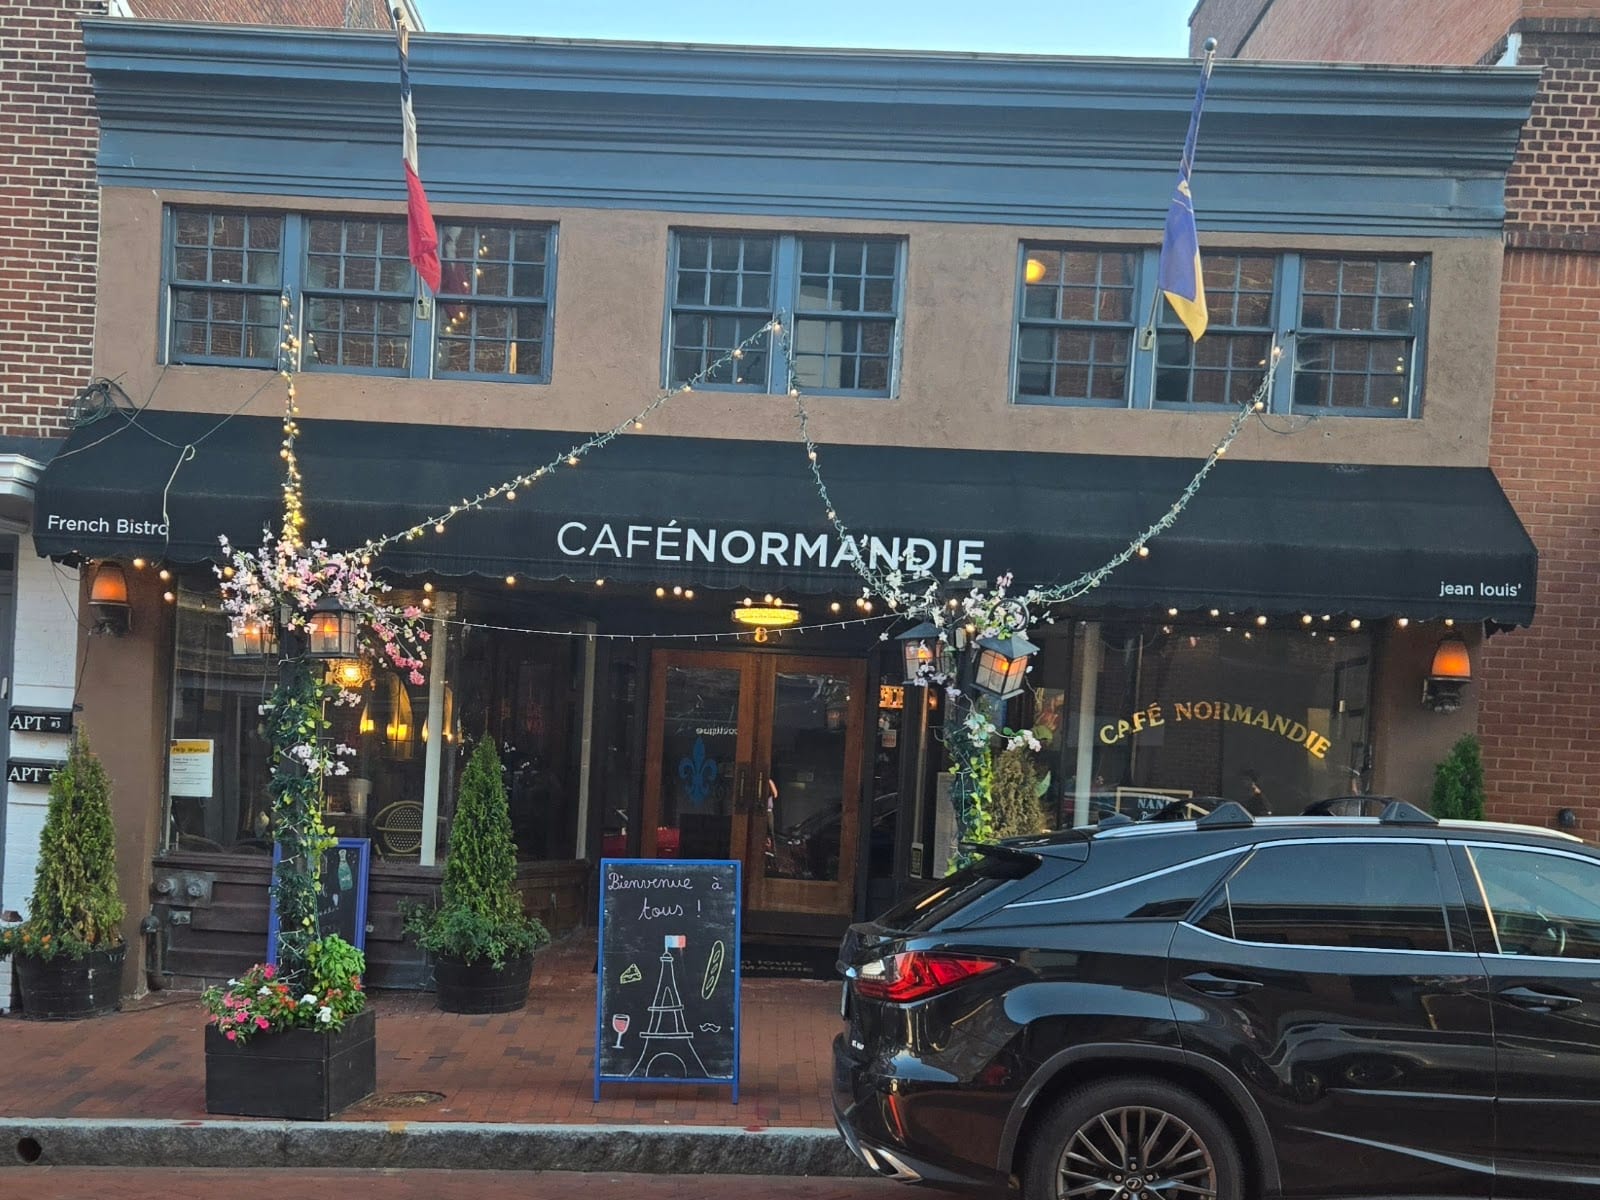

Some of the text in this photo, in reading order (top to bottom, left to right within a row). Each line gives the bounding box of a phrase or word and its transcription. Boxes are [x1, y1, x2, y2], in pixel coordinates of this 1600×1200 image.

[48, 514, 169, 536] French Bistro
[1439, 581, 1522, 597] jean louis'
[10, 715, 46, 730] APT
[1099, 701, 1332, 759] CAFÉ NORMANDIE
[8, 766, 43, 782] APT
[608, 873, 723, 890] Bienvenue à
[638, 897, 683, 920] tous
